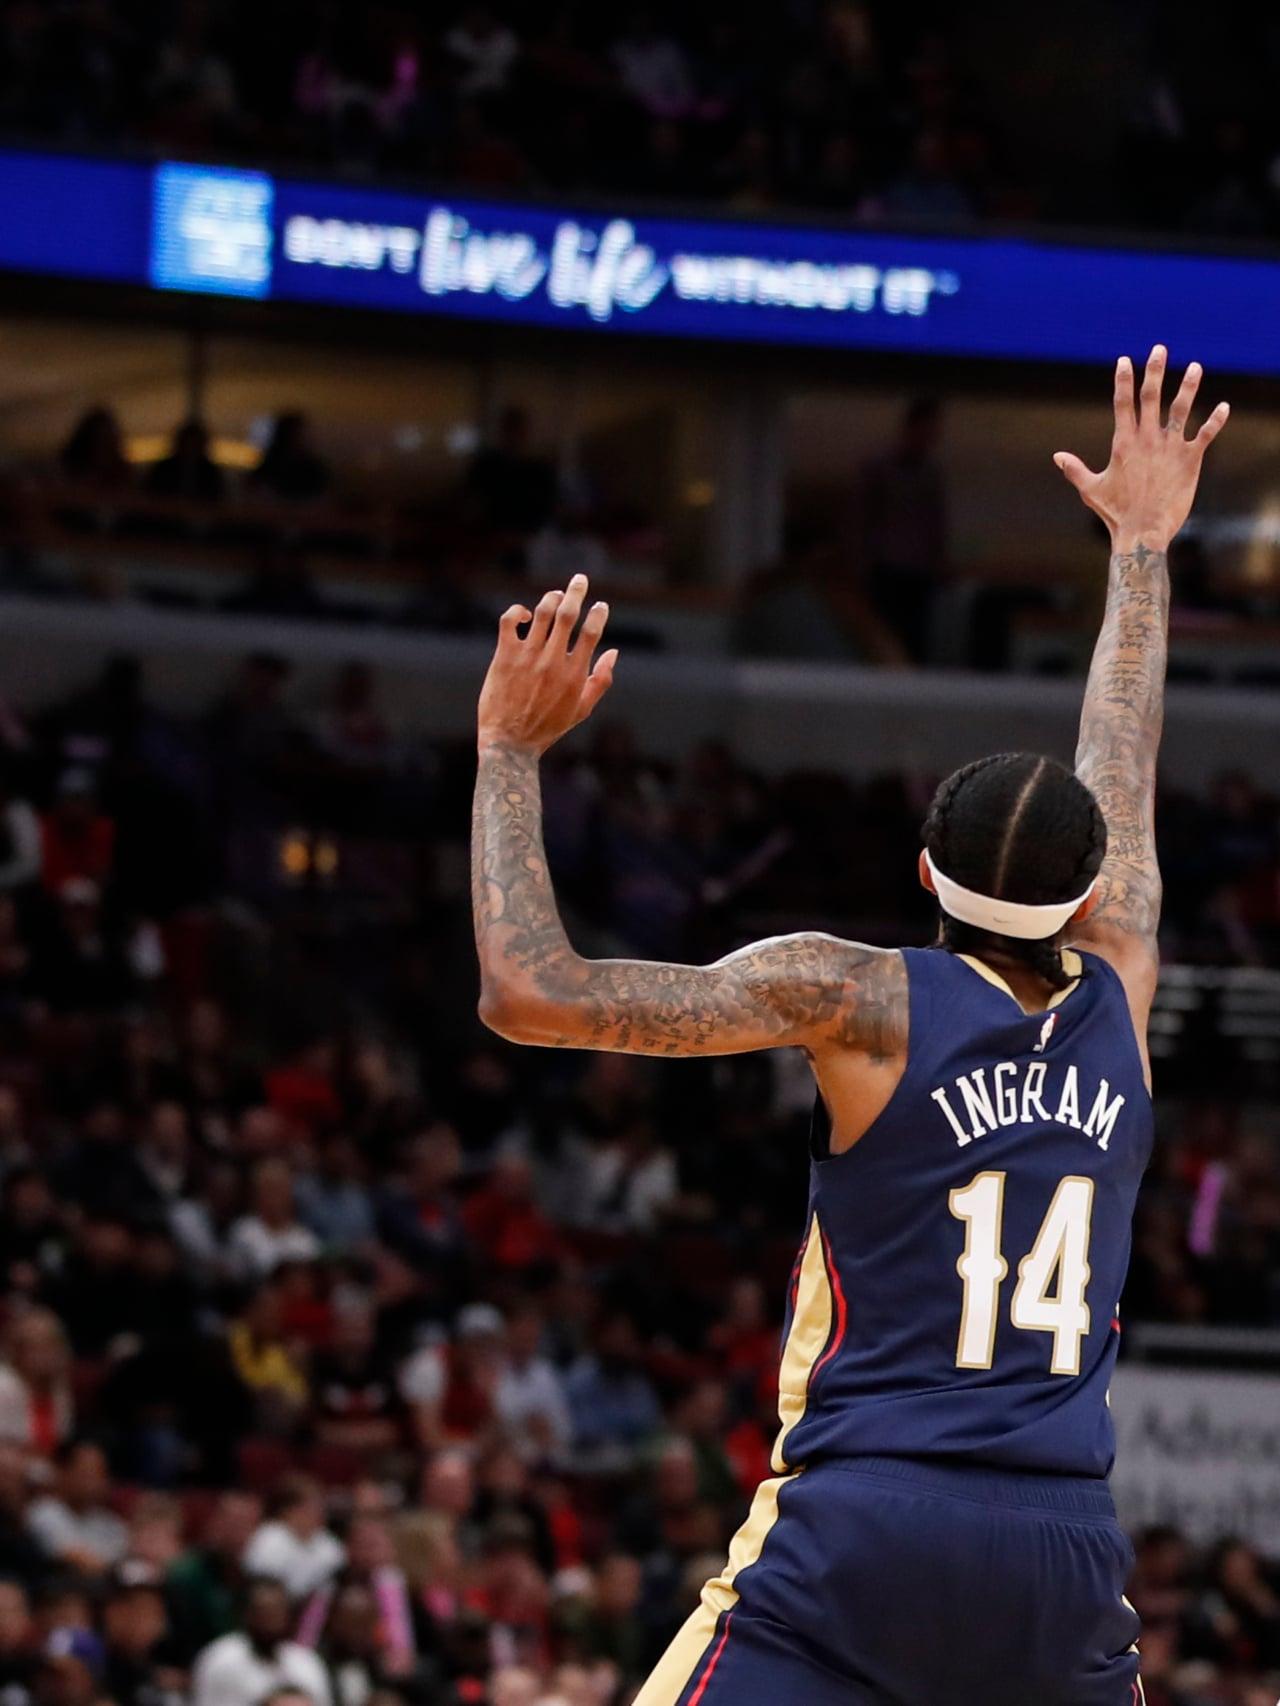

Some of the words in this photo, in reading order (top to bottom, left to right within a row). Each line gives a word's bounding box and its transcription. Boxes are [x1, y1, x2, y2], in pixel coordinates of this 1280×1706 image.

[284, 214, 419, 273] DON'T
[420, 207, 545, 300] live
[547, 218, 668, 321] life
[671, 253, 880, 312] WITHOUT
[930, 1061, 1126, 1152] INGRAM
[948, 1170, 1096, 1376] 14
